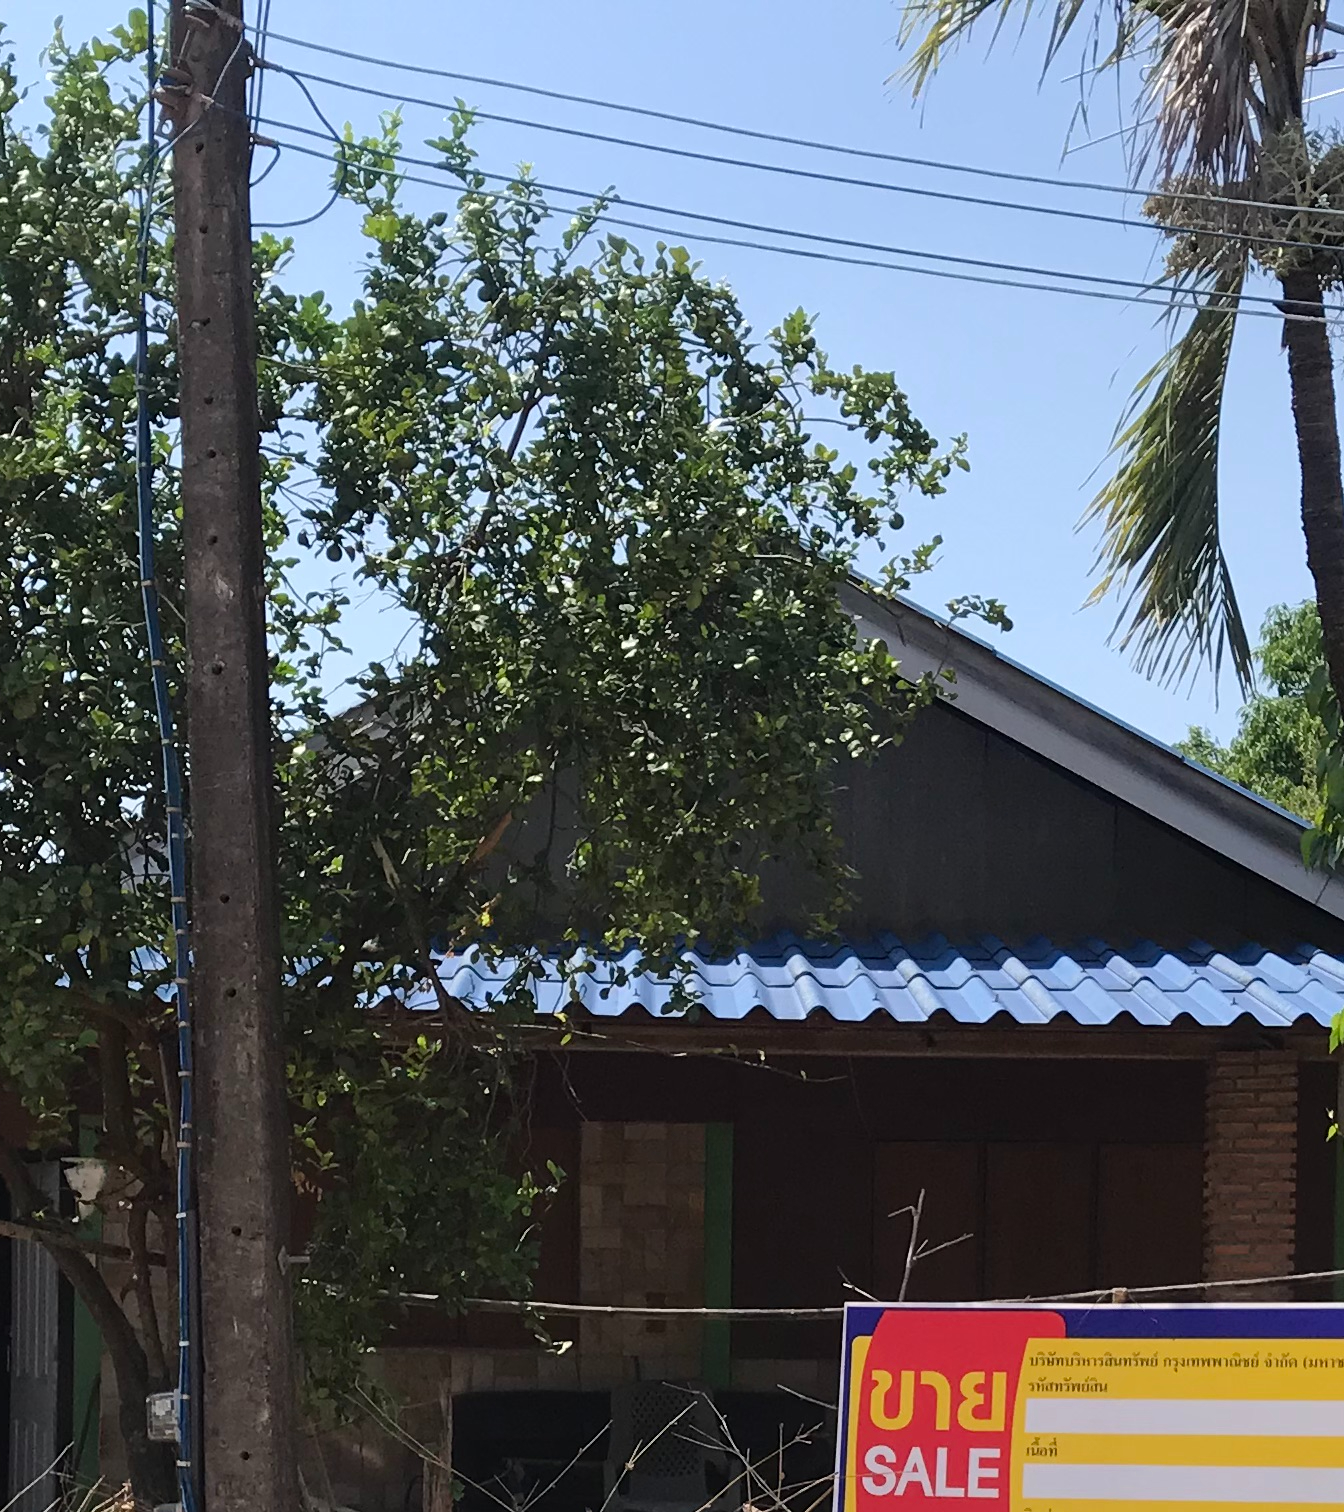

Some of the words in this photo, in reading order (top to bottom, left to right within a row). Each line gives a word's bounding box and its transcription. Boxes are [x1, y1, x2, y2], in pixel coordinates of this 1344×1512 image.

[1264, 1352, 1298, 1369] จำกัด
[1027, 1376, 1108, 1393] รหัสทรัพย์สิน
[869, 1369, 1007, 1432] ขาย
[1026, 1437, 1058, 1457] เนื้อที่
[862, 1445, 1001, 1499] SALE
